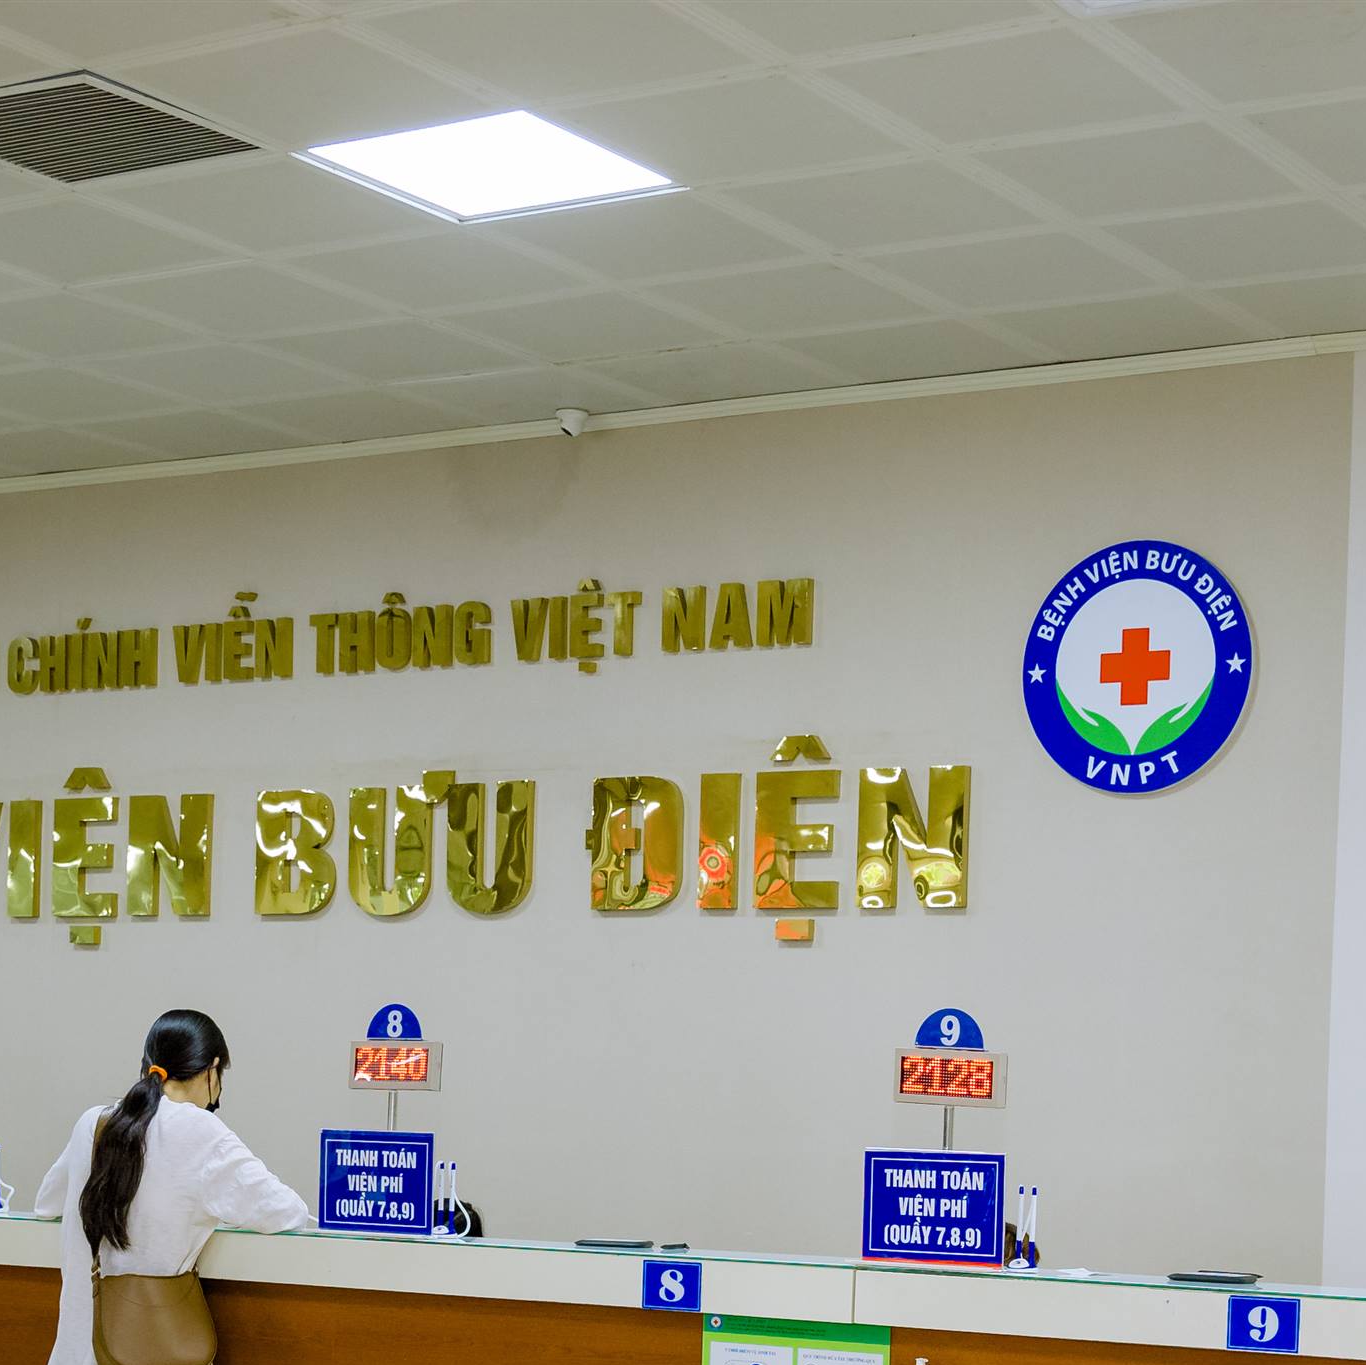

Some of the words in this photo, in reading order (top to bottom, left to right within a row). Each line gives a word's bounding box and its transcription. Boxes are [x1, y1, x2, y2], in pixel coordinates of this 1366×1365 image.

[1037, 577, 1086, 642] BỆNH
[1083, 550, 1139, 584] VIỆN
[1145, 550, 1197, 581] BƯU
[1193, 573, 1238, 632] ĐIỆN
[7, 617, 159, 694] CHÍNH
[173, 592, 294, 685] VIỄN
[309, 592, 493, 674] THÔNG
[510, 578, 643, 674] VIỆT
[661, 578, 815, 653] NAM
[1086, 751, 1181, 786] VNPT
[254, 770, 536, 917] BƯU
[586, 735, 972, 942] ĐIỆN
[387, 1010, 403, 1038] 8
[940, 1015, 960, 1046] 9
[902, 1056, 991, 1096] 2128
[336, 1148, 378, 1167] THANH
[382, 1148, 417, 1169] TOÁN
[347, 1171, 377, 1195] VIỆN
[381, 1173, 403, 1193] PHÍ
[884, 1168, 936, 1189] THANH
[941, 1167, 984, 1190] TOÁN
[336, 1194, 374, 1218] (QUẦY
[377, 1201, 415, 1221] 7,8,9)
[898, 1194, 935, 1219] VIỆN
[940, 1195, 967, 1218] PHÍ
[884, 1219, 932, 1245] (QUẦY
[935, 1226, 982, 1249] 7,8,9)
[659, 1269, 685, 1302] 8
[1248, 1306, 1279, 1342] 9
